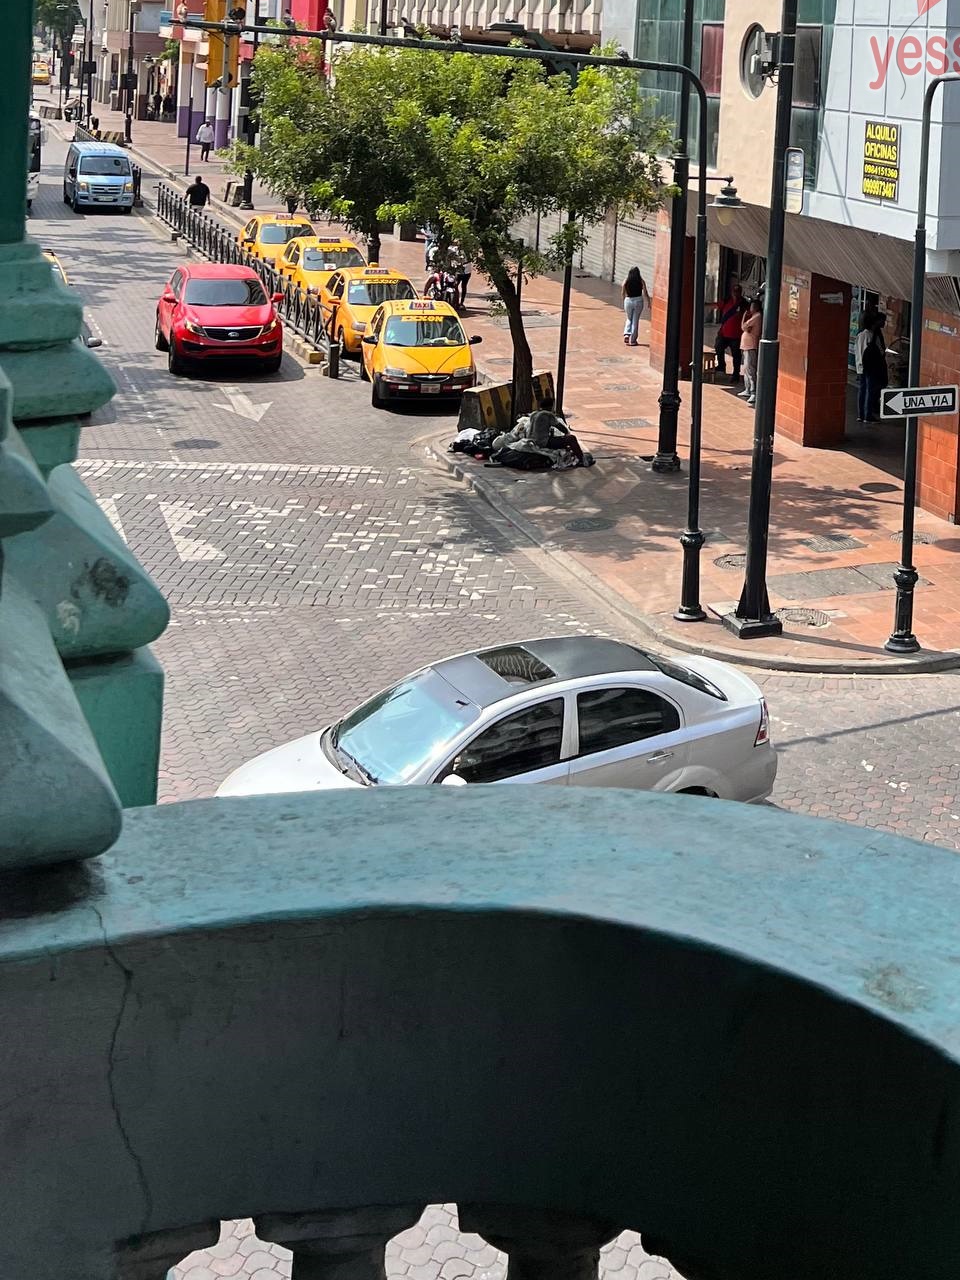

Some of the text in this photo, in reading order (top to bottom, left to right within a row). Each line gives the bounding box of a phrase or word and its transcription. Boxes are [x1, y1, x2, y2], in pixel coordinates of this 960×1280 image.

[866, 124, 897, 142] ALQUILO
[865, 142, 897, 161] OFICINAS
[903, 395, 949, 408] UNA VIA
